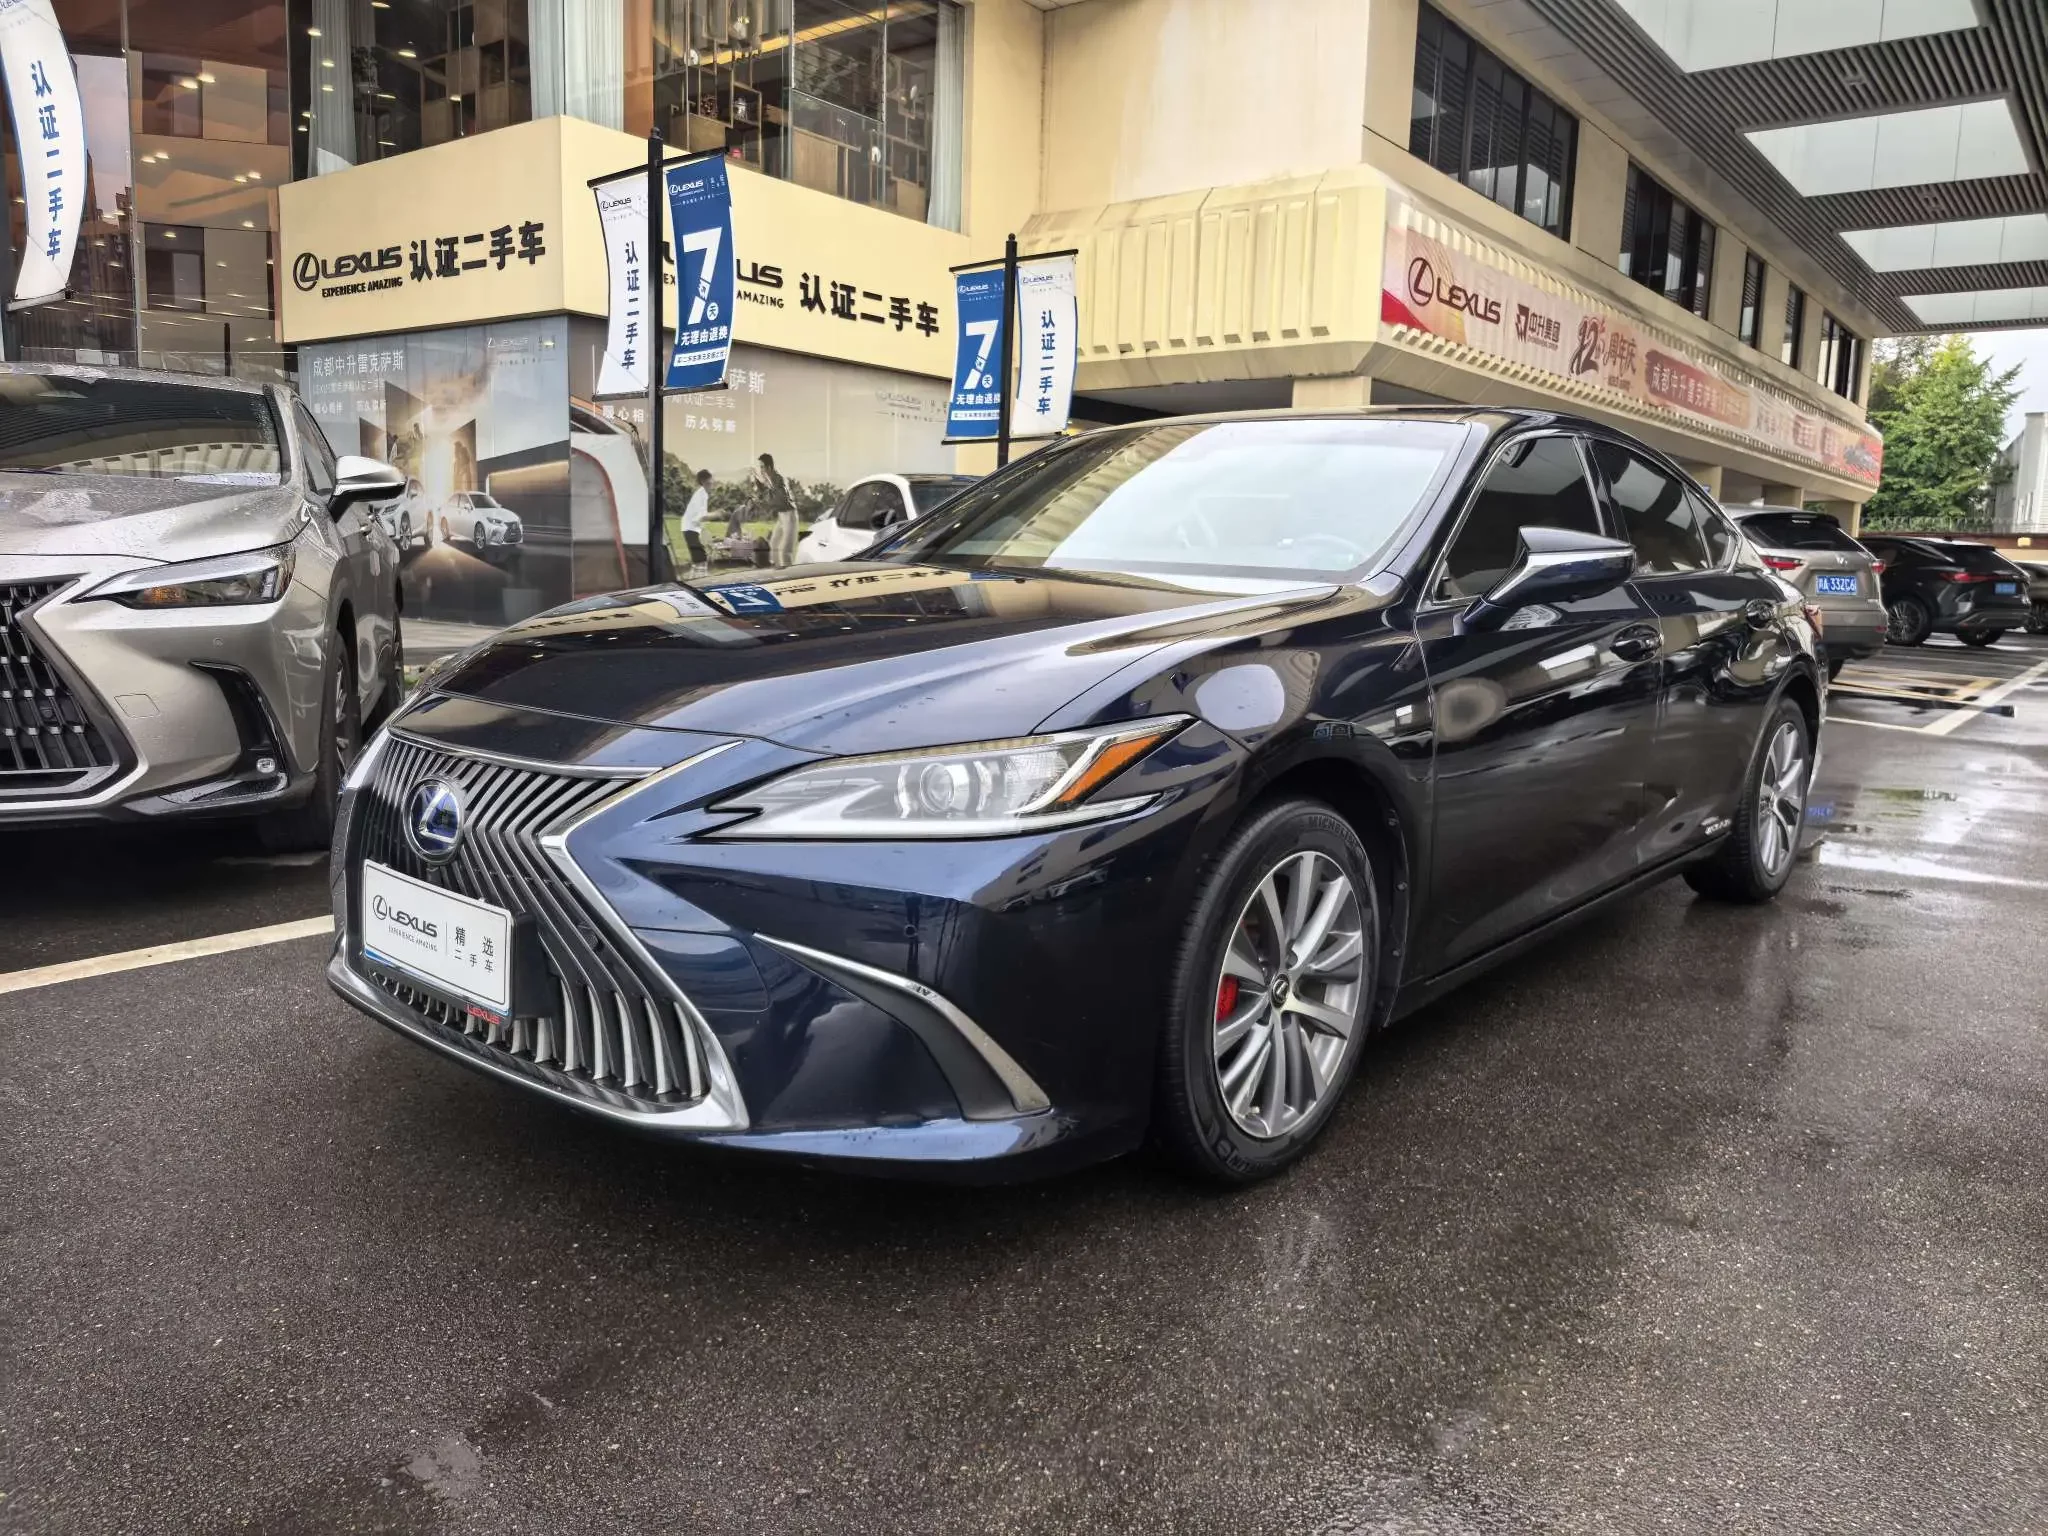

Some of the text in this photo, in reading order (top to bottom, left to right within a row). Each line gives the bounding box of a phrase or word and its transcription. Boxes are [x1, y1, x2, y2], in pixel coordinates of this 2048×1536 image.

[31, 60, 63, 261] 认证二手车
[678, 180, 704, 192] LEXUS
[321, 220, 546, 282] LEXUS 认证二手车
[322, 277, 403, 298] EXPERIENCE AMAZING
[682, 226, 723, 325] 7
[621, 240, 640, 370] 认证二手车
[736, 288, 785, 310] AMAZING
[799, 272, 939, 338] 认证二手车
[1436, 277, 1501, 325] LEXUS
[680, 325, 729, 346] 无理由退换
[963, 319, 999, 390] 7
[313, 349, 404, 377] 成都中升雷克萨斯
[1036, 309, 1056, 415] 认证二手车
[388, 905, 438, 938] LEXUS
[388, 924, 438, 952] EXPERIENCE AMAZING
[467, 1003, 501, 1025] LEXUS
